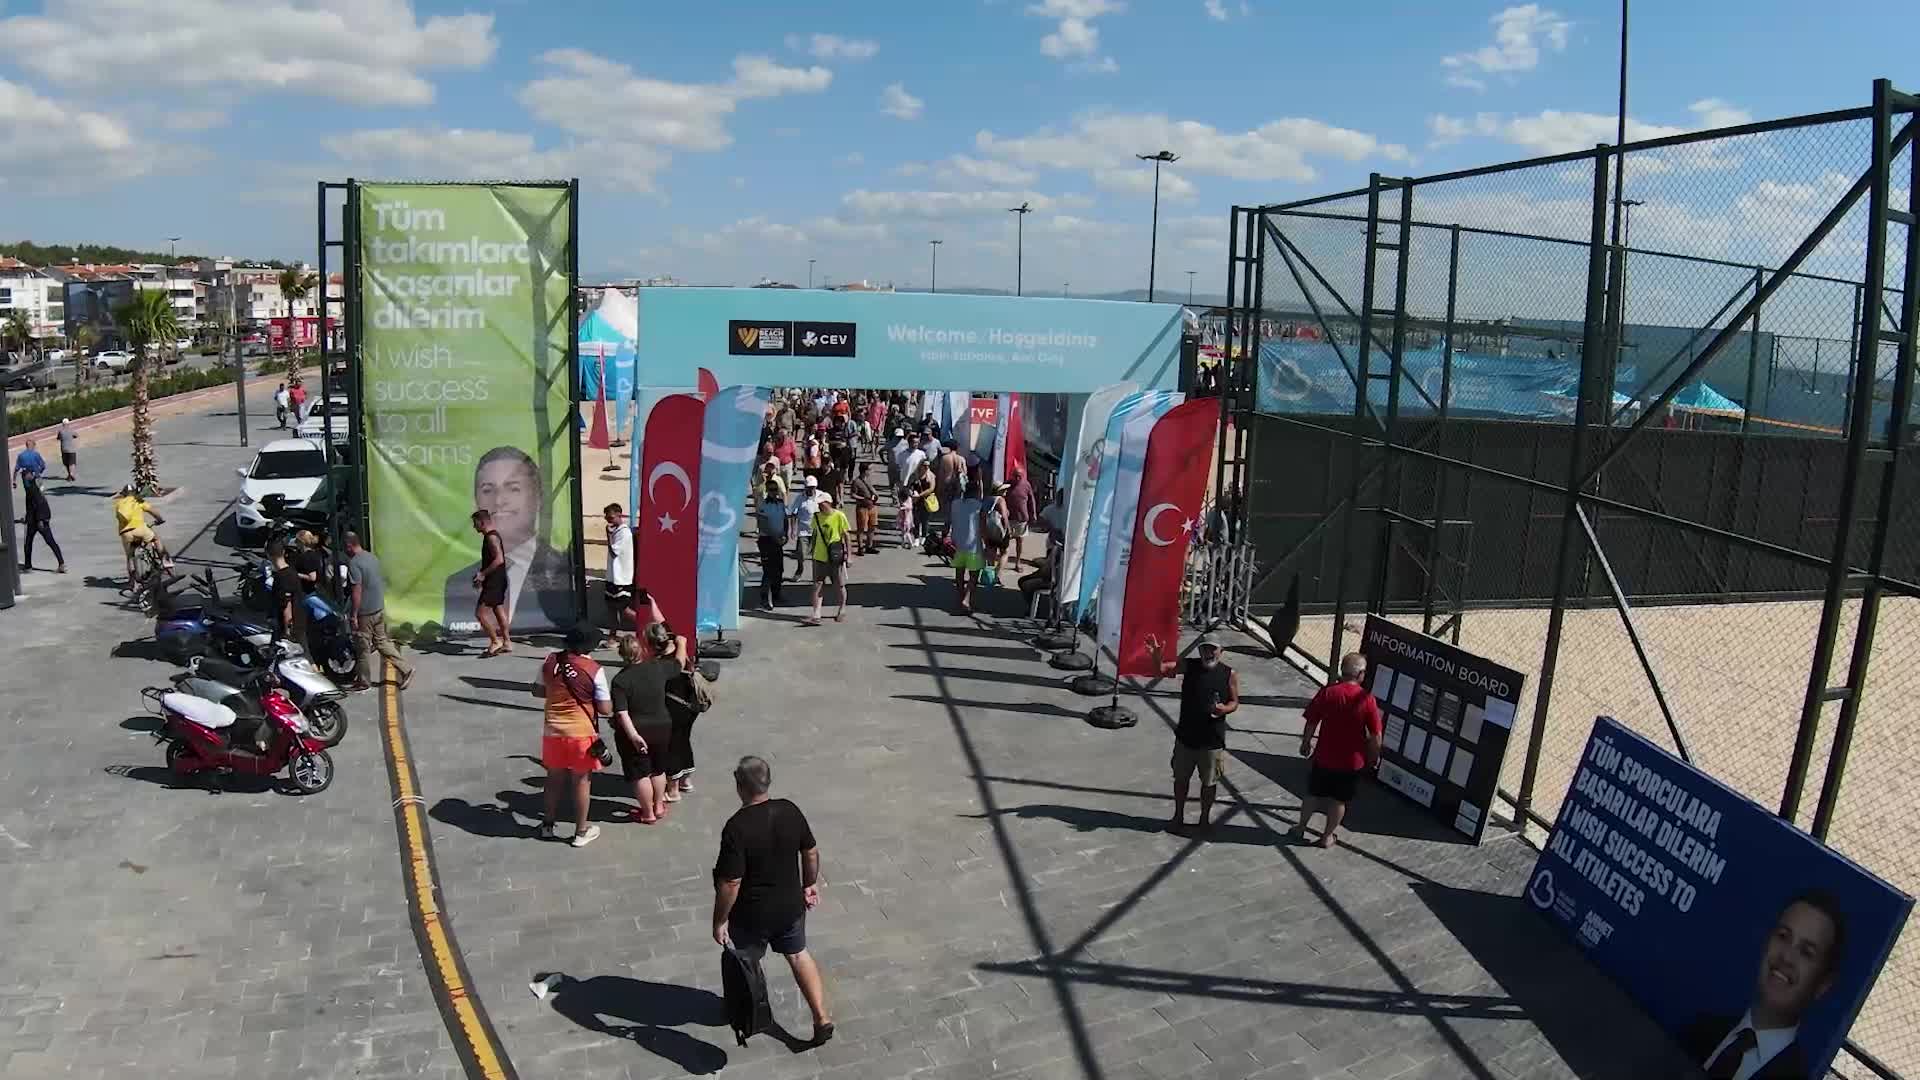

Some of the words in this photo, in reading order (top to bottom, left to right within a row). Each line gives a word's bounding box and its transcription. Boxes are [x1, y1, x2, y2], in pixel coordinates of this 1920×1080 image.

[372, 200, 446, 231] Tüm
[374, 302, 485, 329] dilerim
[820, 334, 847, 345] CEV
[888, 324, 977, 345] Welcome
[387, 343, 452, 369] wish
[375, 377, 489, 401] success
[376, 407, 407, 432] to
[416, 405, 447, 432] all
[971, 407, 994, 418] TVF
[1369, 631, 1456, 674] INFORMATION
[1458, 667, 1509, 697] BOARD
[1589, 736, 1622, 775] TÜM
[1618, 756, 1722, 840] SPORCULARA
[1575, 767, 1660, 841] BAŞARILAR
[1655, 819, 1727, 885] DİLERİM
[1562, 800, 1574, 821] I
[1570, 804, 1608, 847] WISH
[1604, 830, 1674, 896] SUCCESS
[1670, 877, 1697, 912] TO
[1550, 829, 1576, 865] ALL
[1573, 847, 1645, 917] ATHLETES
